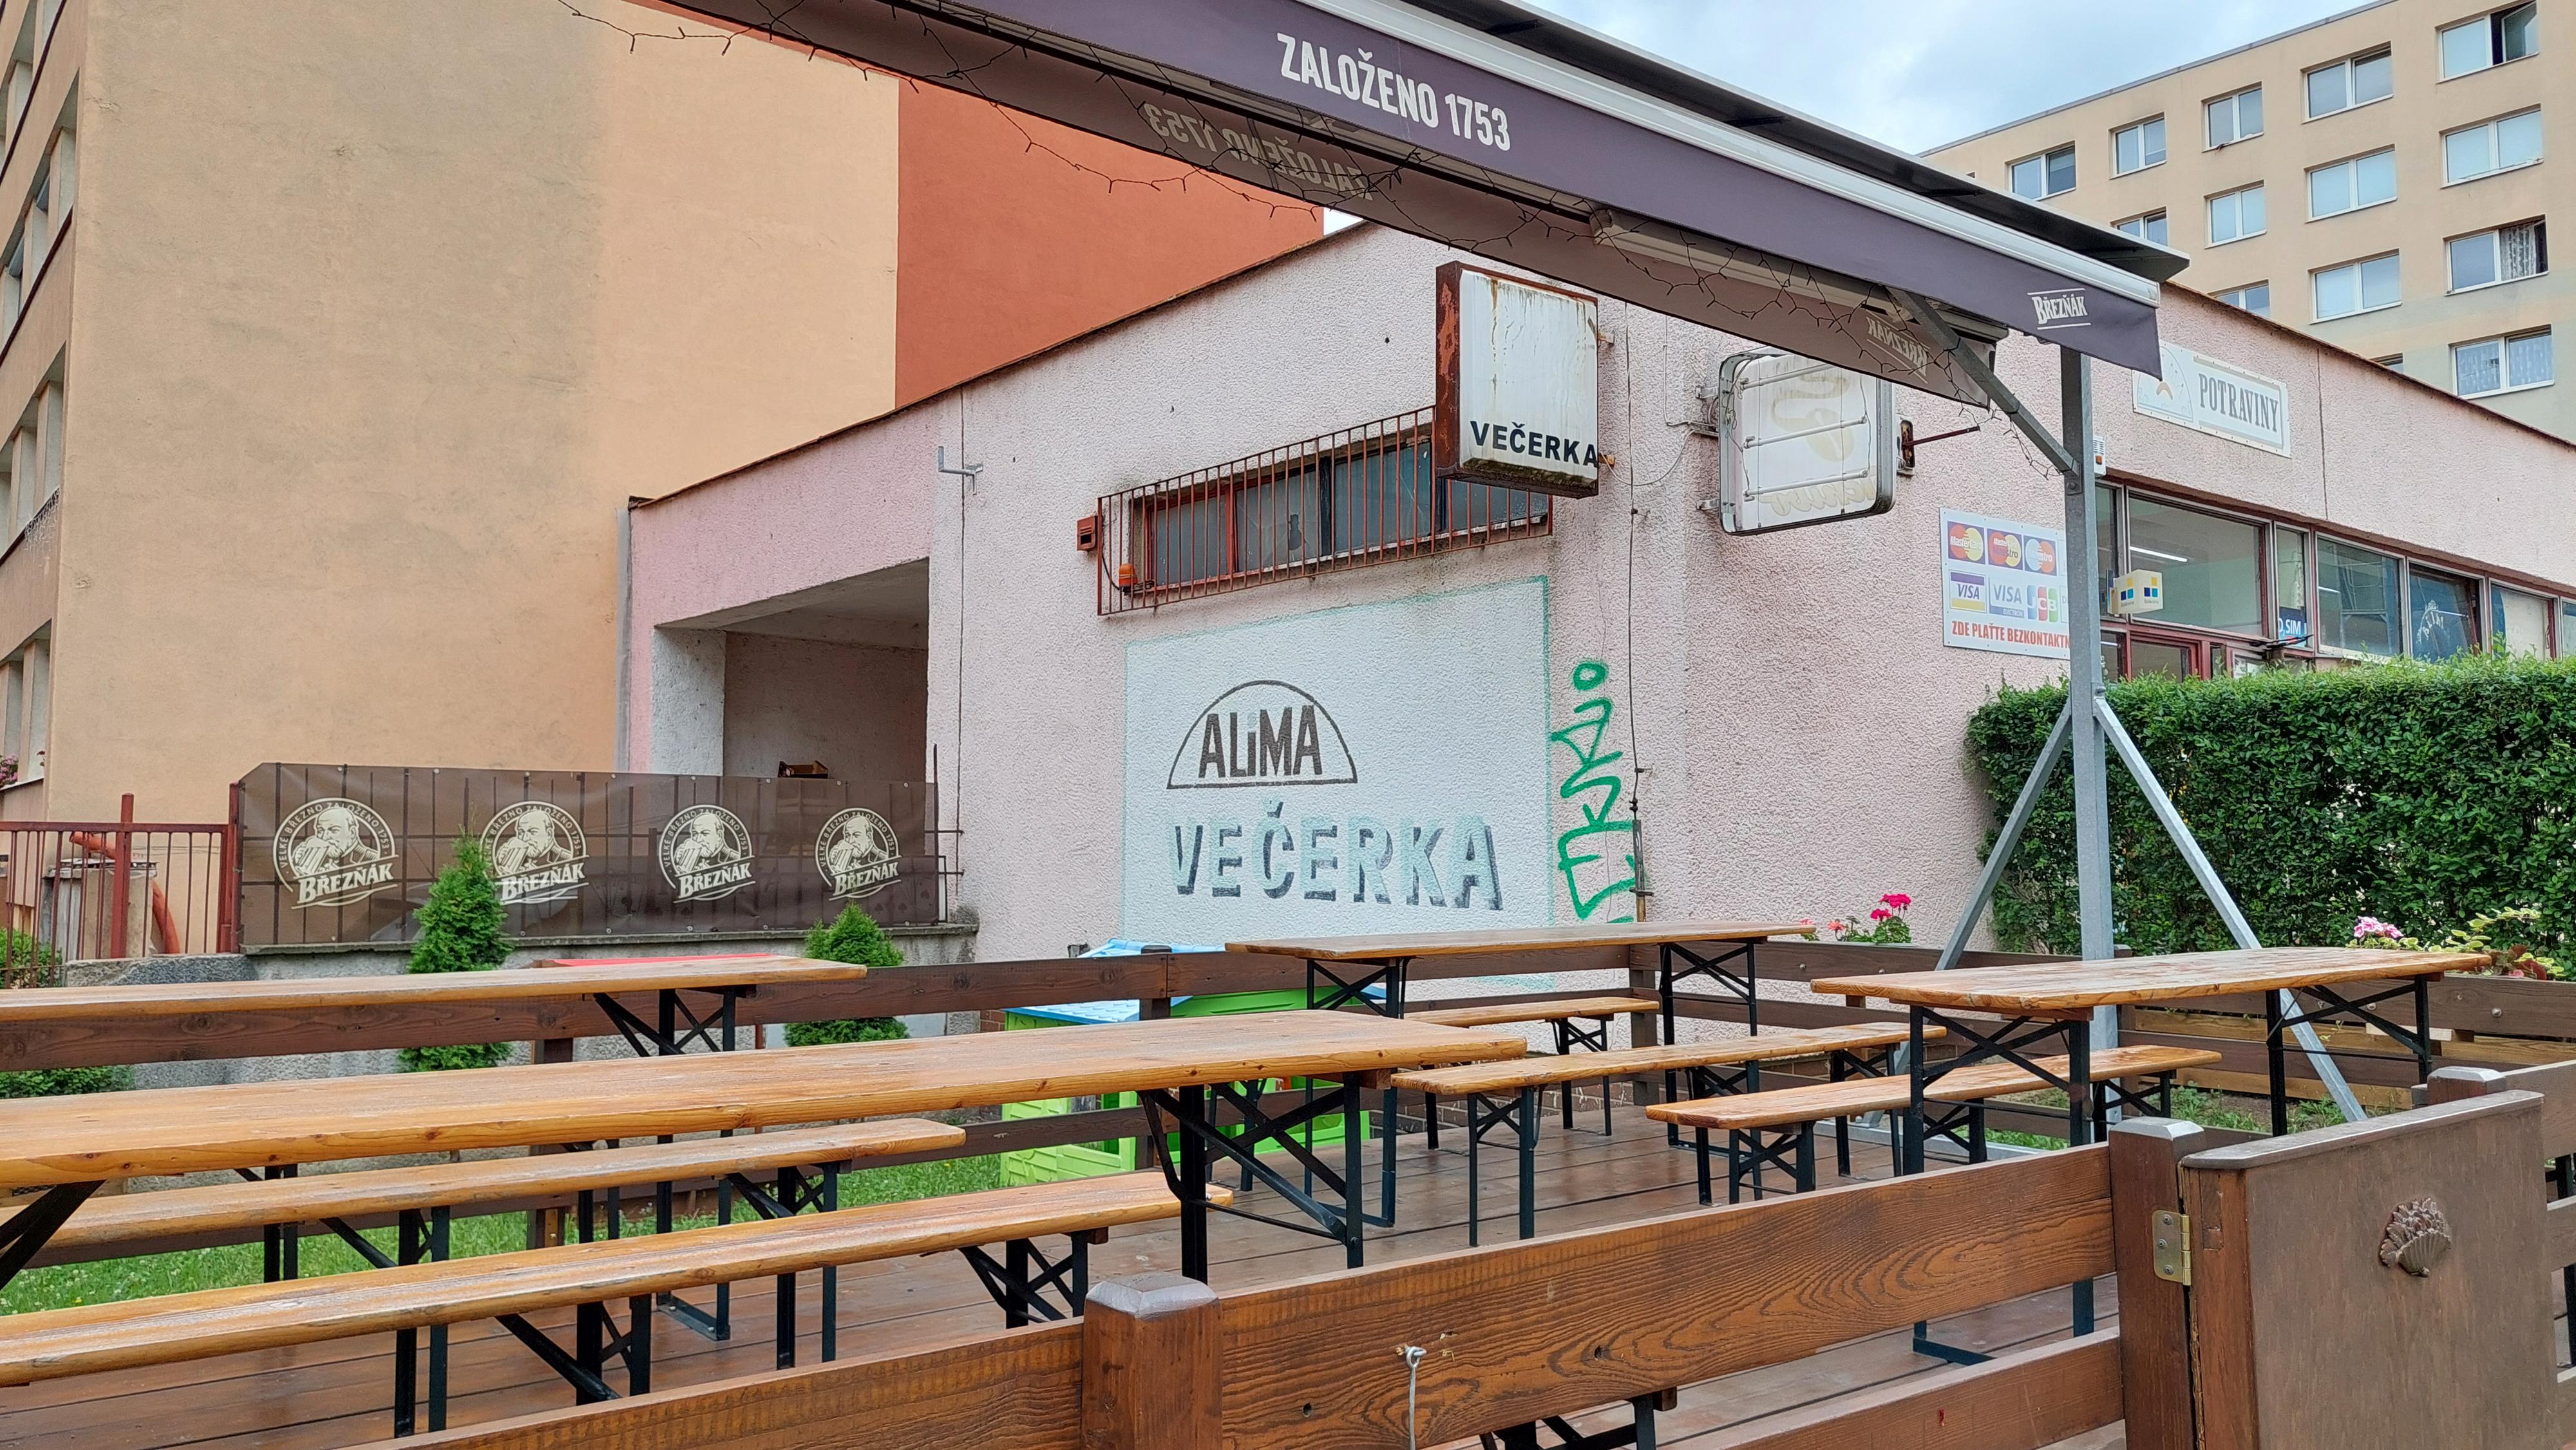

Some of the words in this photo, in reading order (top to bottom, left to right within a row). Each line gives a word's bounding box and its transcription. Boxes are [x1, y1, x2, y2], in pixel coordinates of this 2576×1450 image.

[1276, 32, 1439, 128] ZALOŽENO
[1444, 93, 1511, 151] 1753
[2031, 295, 2088, 324] BŘEZŇÁK
[2198, 373, 2278, 432] POTRAVINY
[1470, 420, 1598, 469] VEČERKA
[1957, 583, 1980, 600] VISA
[1993, 584, 2022, 604] VISA
[1952, 620, 1969, 637] ZDE
[1972, 622, 2005, 641] PLAŤTE
[2003, 608, 2023, 617] ELECTRON
[2286, 619, 2301, 636] SIM
[279, 836, 289, 869] VELKÉ
[285, 805, 323, 834] BŘEZNO
[377, 829, 390, 849] 1753
[490, 807, 522, 835] BŘEZNO
[571, 830, 582, 850] 1753
[668, 811, 696, 836] BŘEZNO
[738, 833, 748, 851] 1753
[824, 813, 849, 838] BŘEZNO
[886, 834, 895, 851] 1753
[1170, 798, 1503, 910] VEČERKA
[297, 863, 394, 904] BŘEZŇÁK
[500, 863, 585, 901] BŘEZŇÁK
[678, 862, 752, 899] BŘEZŇÁK
[833, 862, 899, 896] BŘEZŇÁK
